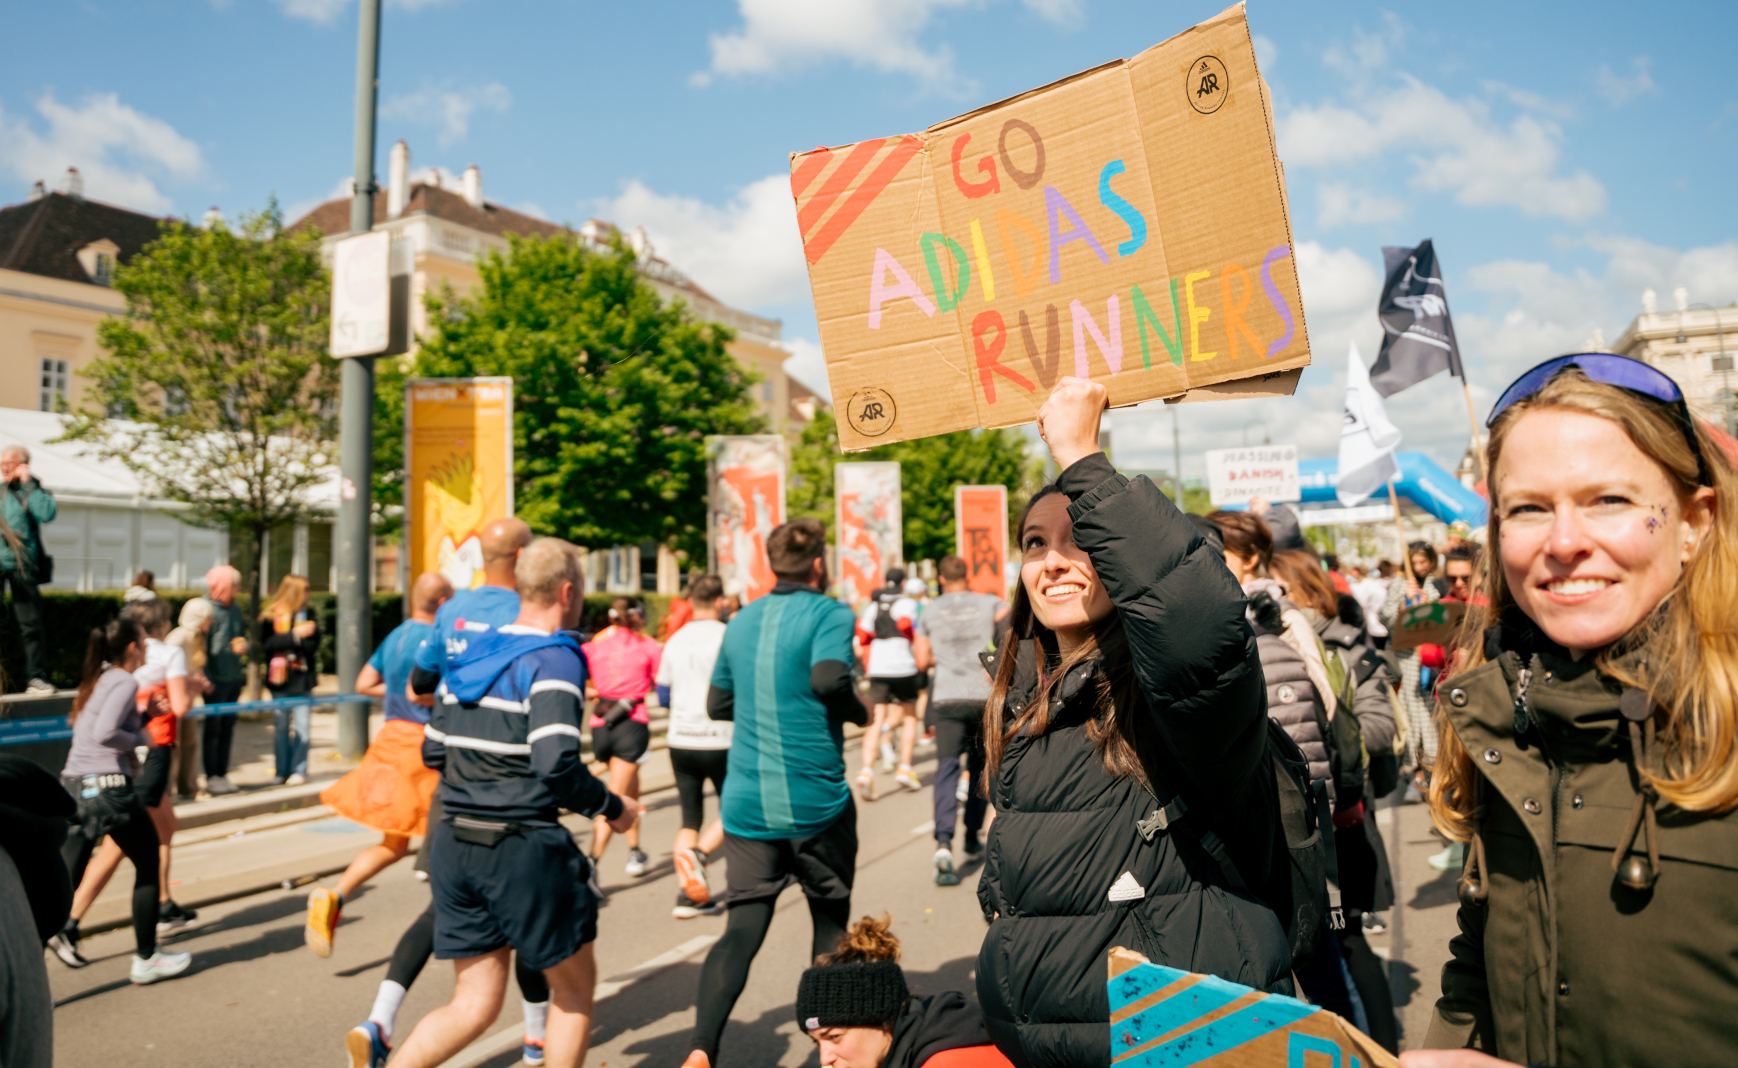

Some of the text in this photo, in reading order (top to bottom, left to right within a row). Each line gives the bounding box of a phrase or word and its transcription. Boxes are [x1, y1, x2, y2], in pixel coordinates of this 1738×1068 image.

[951, 118, 1046, 200] GO
[868, 159, 1147, 330] ADIDAS
[971, 245, 1295, 406] RUNNERS
